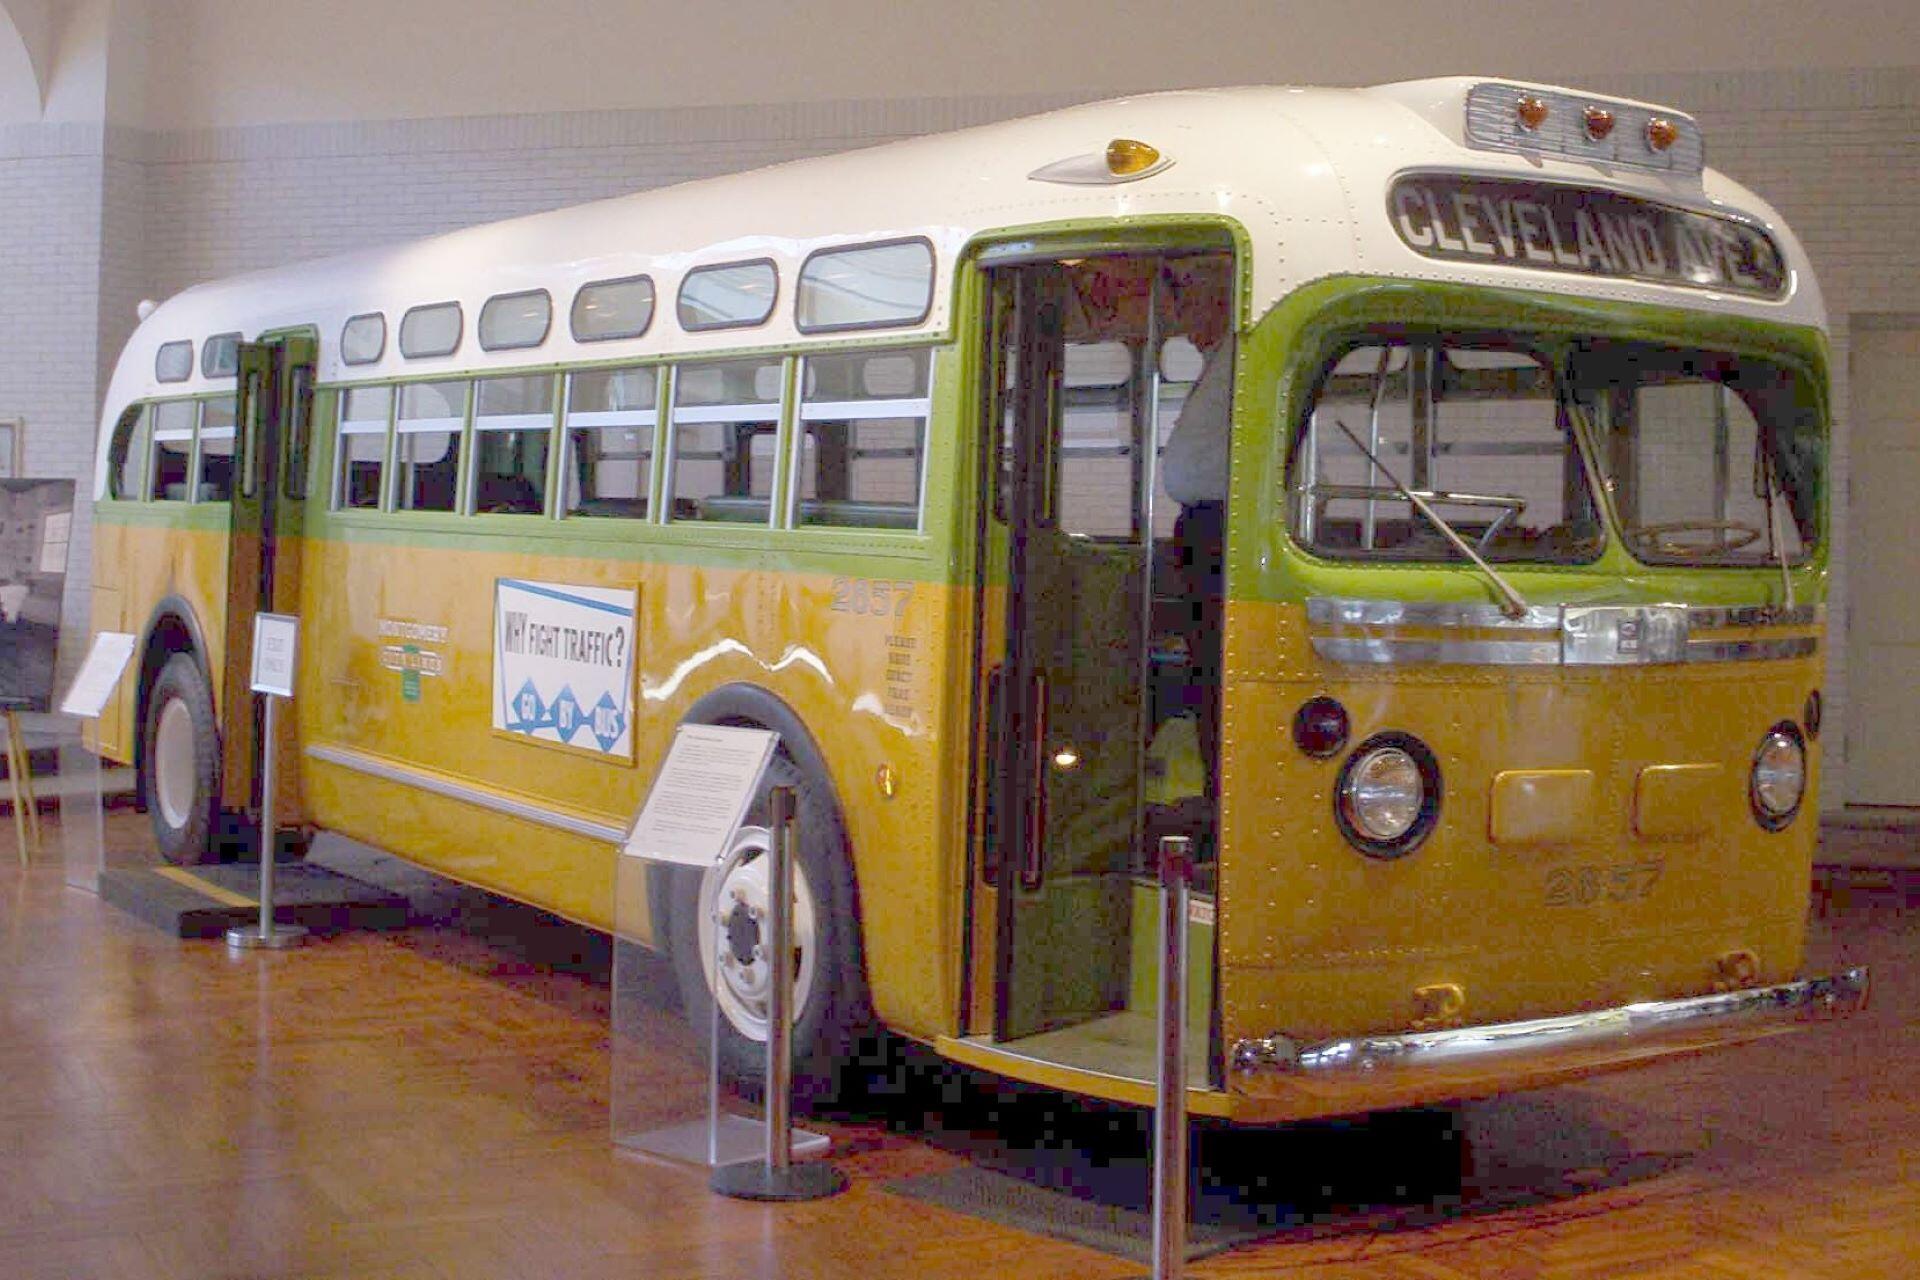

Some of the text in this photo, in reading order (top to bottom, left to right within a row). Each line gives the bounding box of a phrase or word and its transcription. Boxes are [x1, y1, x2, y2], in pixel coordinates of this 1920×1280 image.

[1399, 184, 1664, 275] CLEVELAND
[504, 611, 625, 668] WHY FIGHT TRAFFIC?
[520, 693, 619, 740] GO BY BUS
